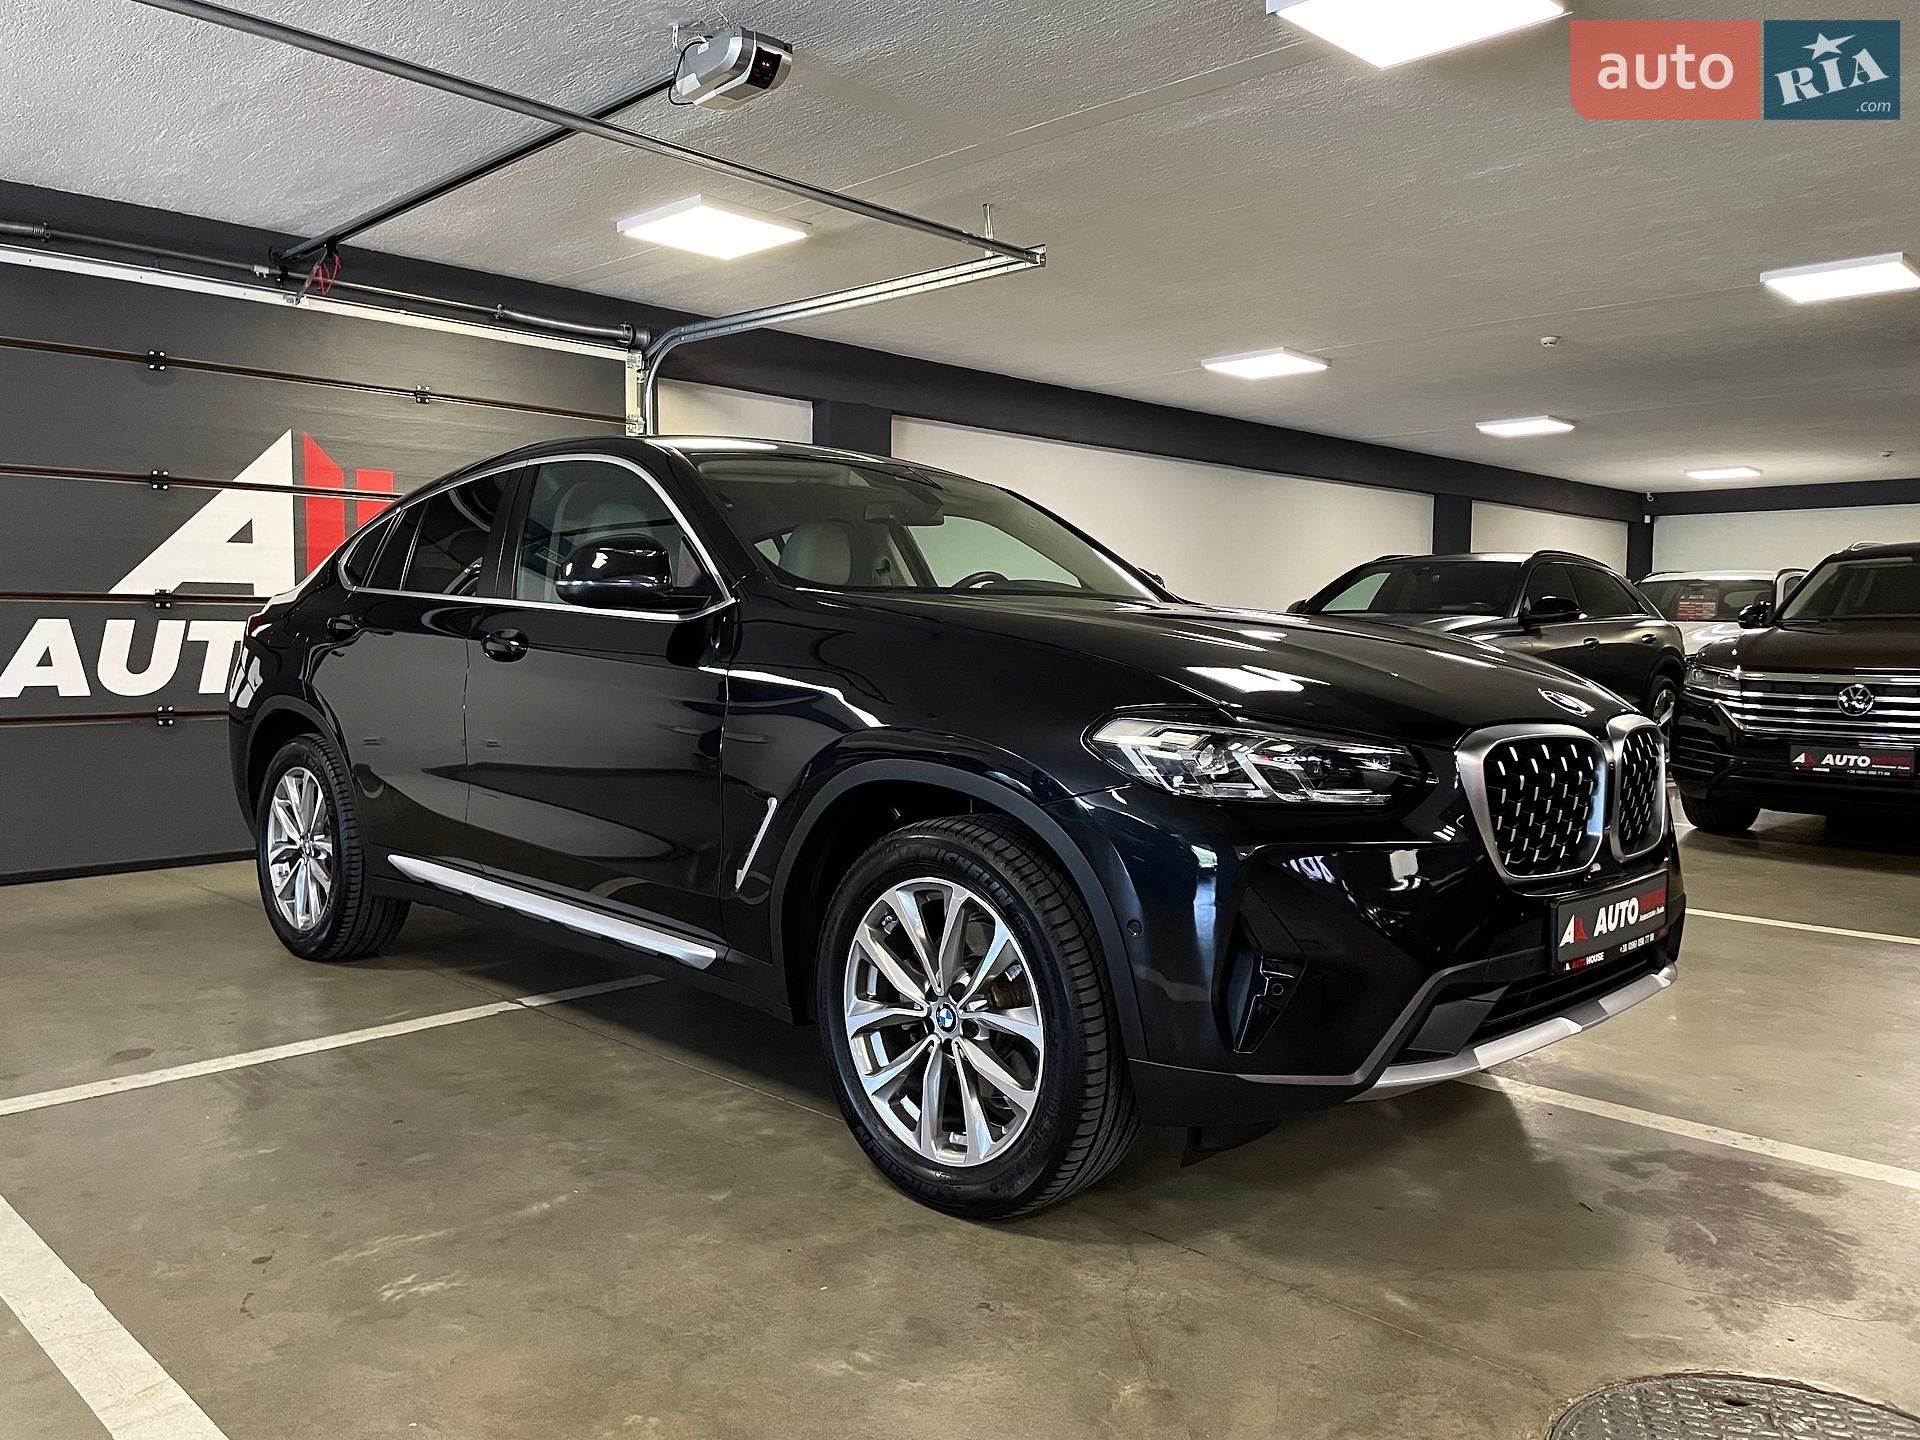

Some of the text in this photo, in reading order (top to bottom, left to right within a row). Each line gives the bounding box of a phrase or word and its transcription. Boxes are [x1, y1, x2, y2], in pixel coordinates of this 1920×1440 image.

[1820, 753, 1871, 767] AUTO
[1593, 897, 1639, 937] AUTO
[1586, 952, 1604, 965] HOUSE
